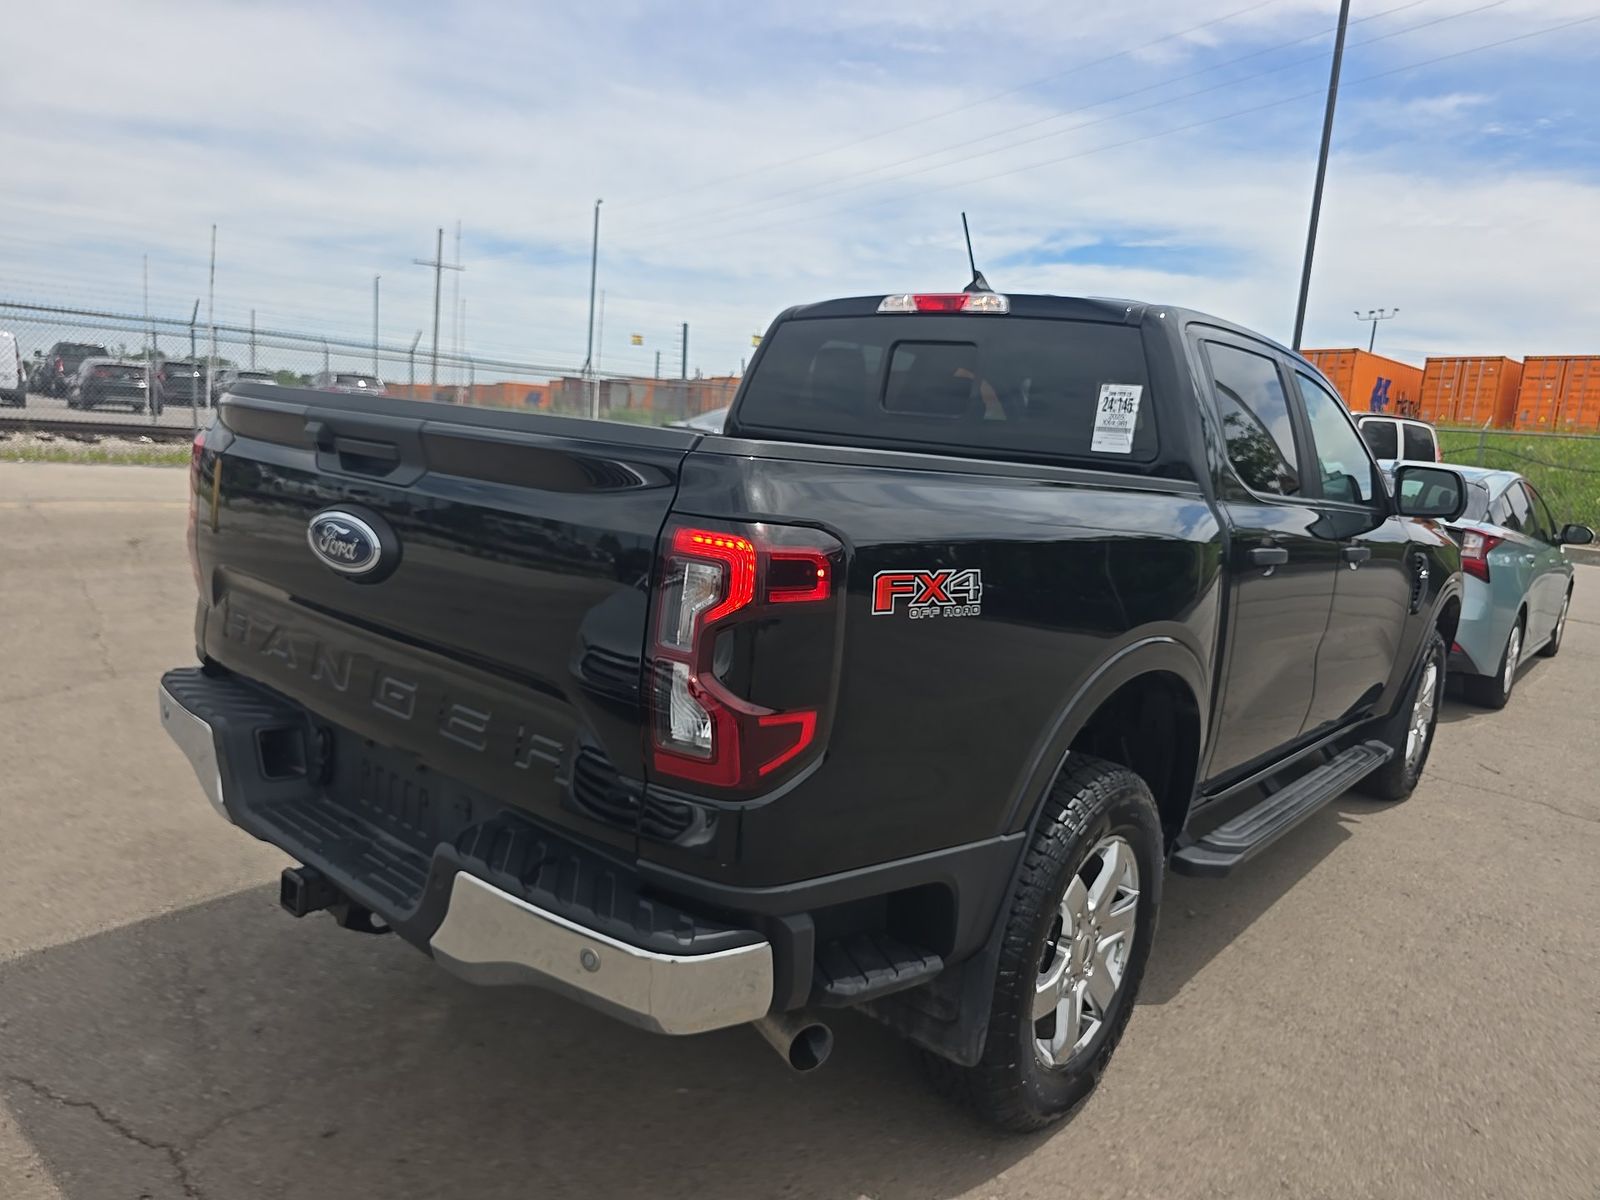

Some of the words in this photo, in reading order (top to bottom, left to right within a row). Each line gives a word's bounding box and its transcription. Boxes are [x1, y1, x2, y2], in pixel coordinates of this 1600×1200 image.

[319, 522, 359, 560] Ford
[873, 569, 982, 617] FX4
[908, 606, 942, 620] OFF
[943, 604, 982, 617] ROAD
[223, 594, 573, 786] RANGER
